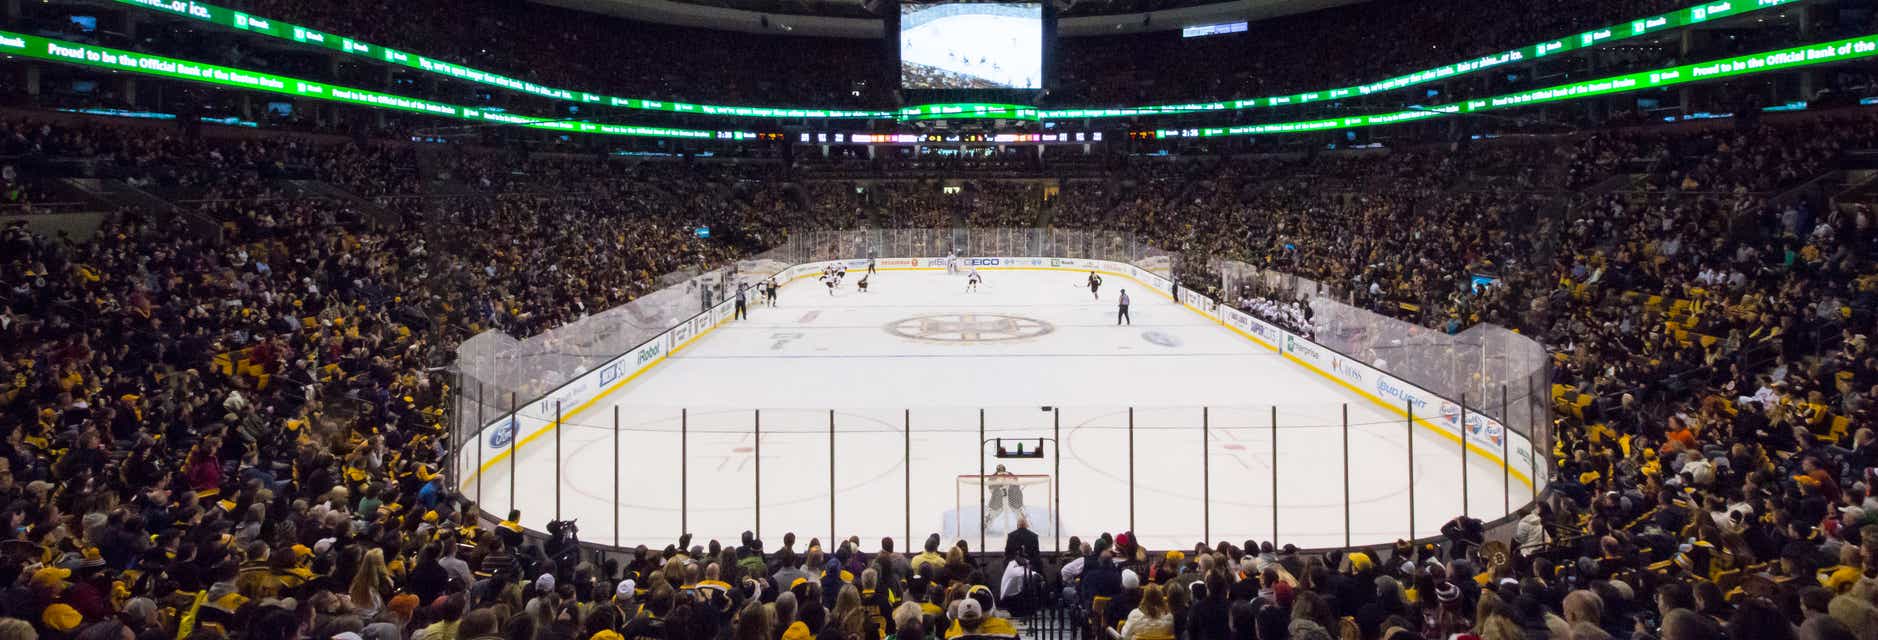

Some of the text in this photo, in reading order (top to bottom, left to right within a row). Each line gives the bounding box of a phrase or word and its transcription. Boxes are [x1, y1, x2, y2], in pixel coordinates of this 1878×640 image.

[189, 1, 211, 17] ice.
[1707, 3, 1731, 13] Bank
[48, 43, 85, 58] Proud
[86, 51, 100, 60] to
[101, 51, 117, 63] be
[118, 55, 138, 66] the
[139, 58, 176, 72] Official
[177, 64, 201, 75] Bank
[202, 69, 213, 77] of
[214, 70, 229, 80] the
[1693, 64, 1720, 76] Proud
[1733, 61, 1746, 70] be
[1747, 59, 1765, 68] the
[1766, 51, 1805, 65] Official
[1806, 46, 1836, 59] Bank
[1837, 43, 1852, 54] of
[1853, 41, 1876, 52] the
[963, 258, 1000, 266] GEICO
